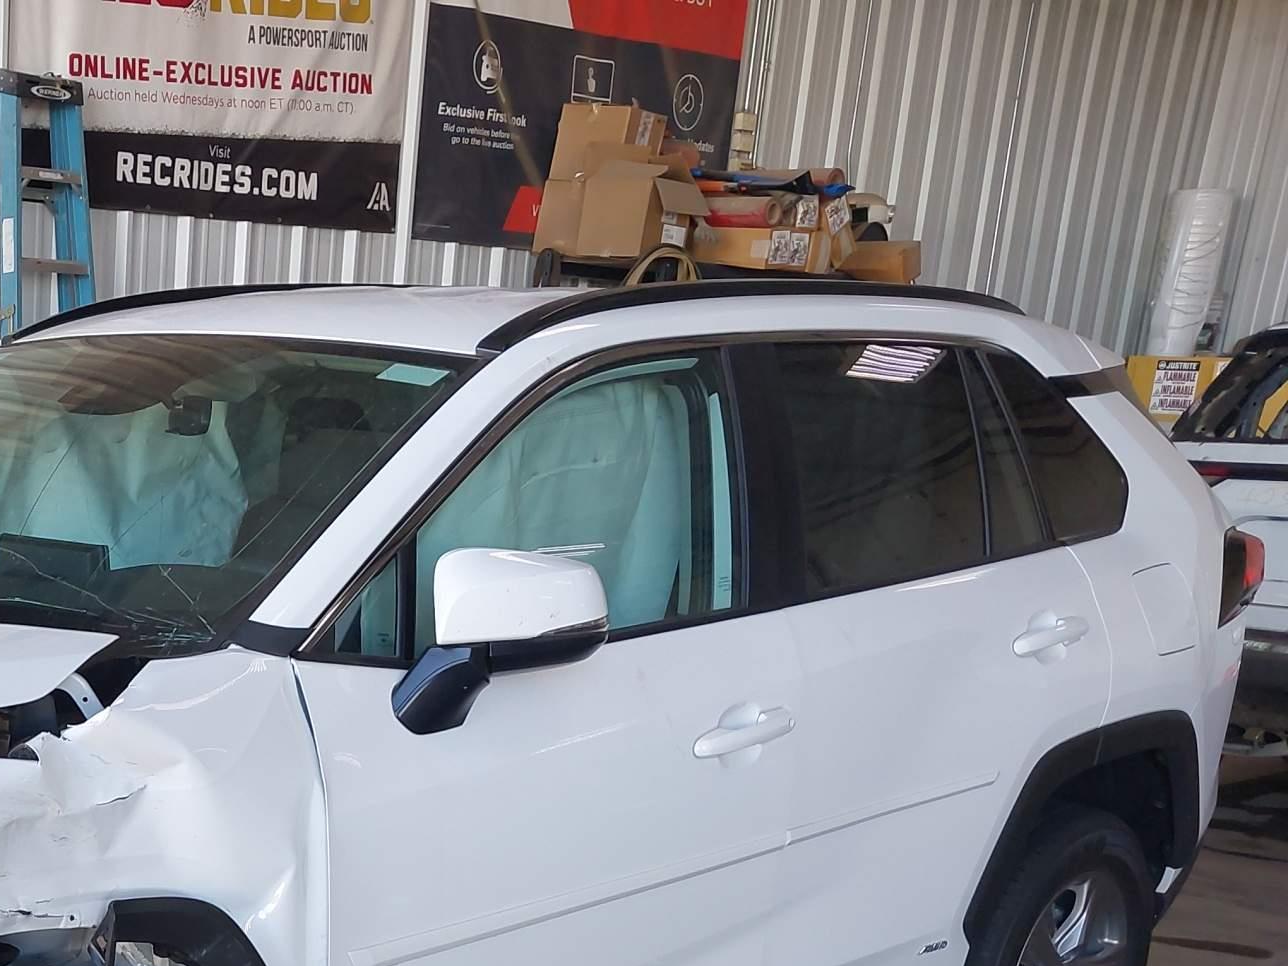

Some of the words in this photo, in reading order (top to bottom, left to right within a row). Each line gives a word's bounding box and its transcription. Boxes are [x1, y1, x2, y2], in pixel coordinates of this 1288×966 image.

[248, 25, 256, 44] A
[259, 26, 328, 49] POWERSPORT
[328, 30, 369, 52] AUCTION
[68, 53, 282, 90] ONLINE-EXCLUSIVE
[291, 69, 373, 95] AUCTION
[87, 87, 131, 101] Auction
[134, 89, 158, 103] held
[161, 91, 224, 109] Wednesdays
[226, 97, 237, 108] at
[240, 98, 266, 110] noon
[269, 98, 284, 110] ET
[337, 101, 354, 114] CT)
[437, 101, 485, 120] Exclusive
[443, 123, 455, 132] Bid
[451, 136, 461, 145] go
[462, 136, 469, 144] to
[208, 144, 231, 159] Visit
[116, 151, 318, 201] RECRIDES.COM
[1163, 371, 1197, 382] FLAMMABLE
